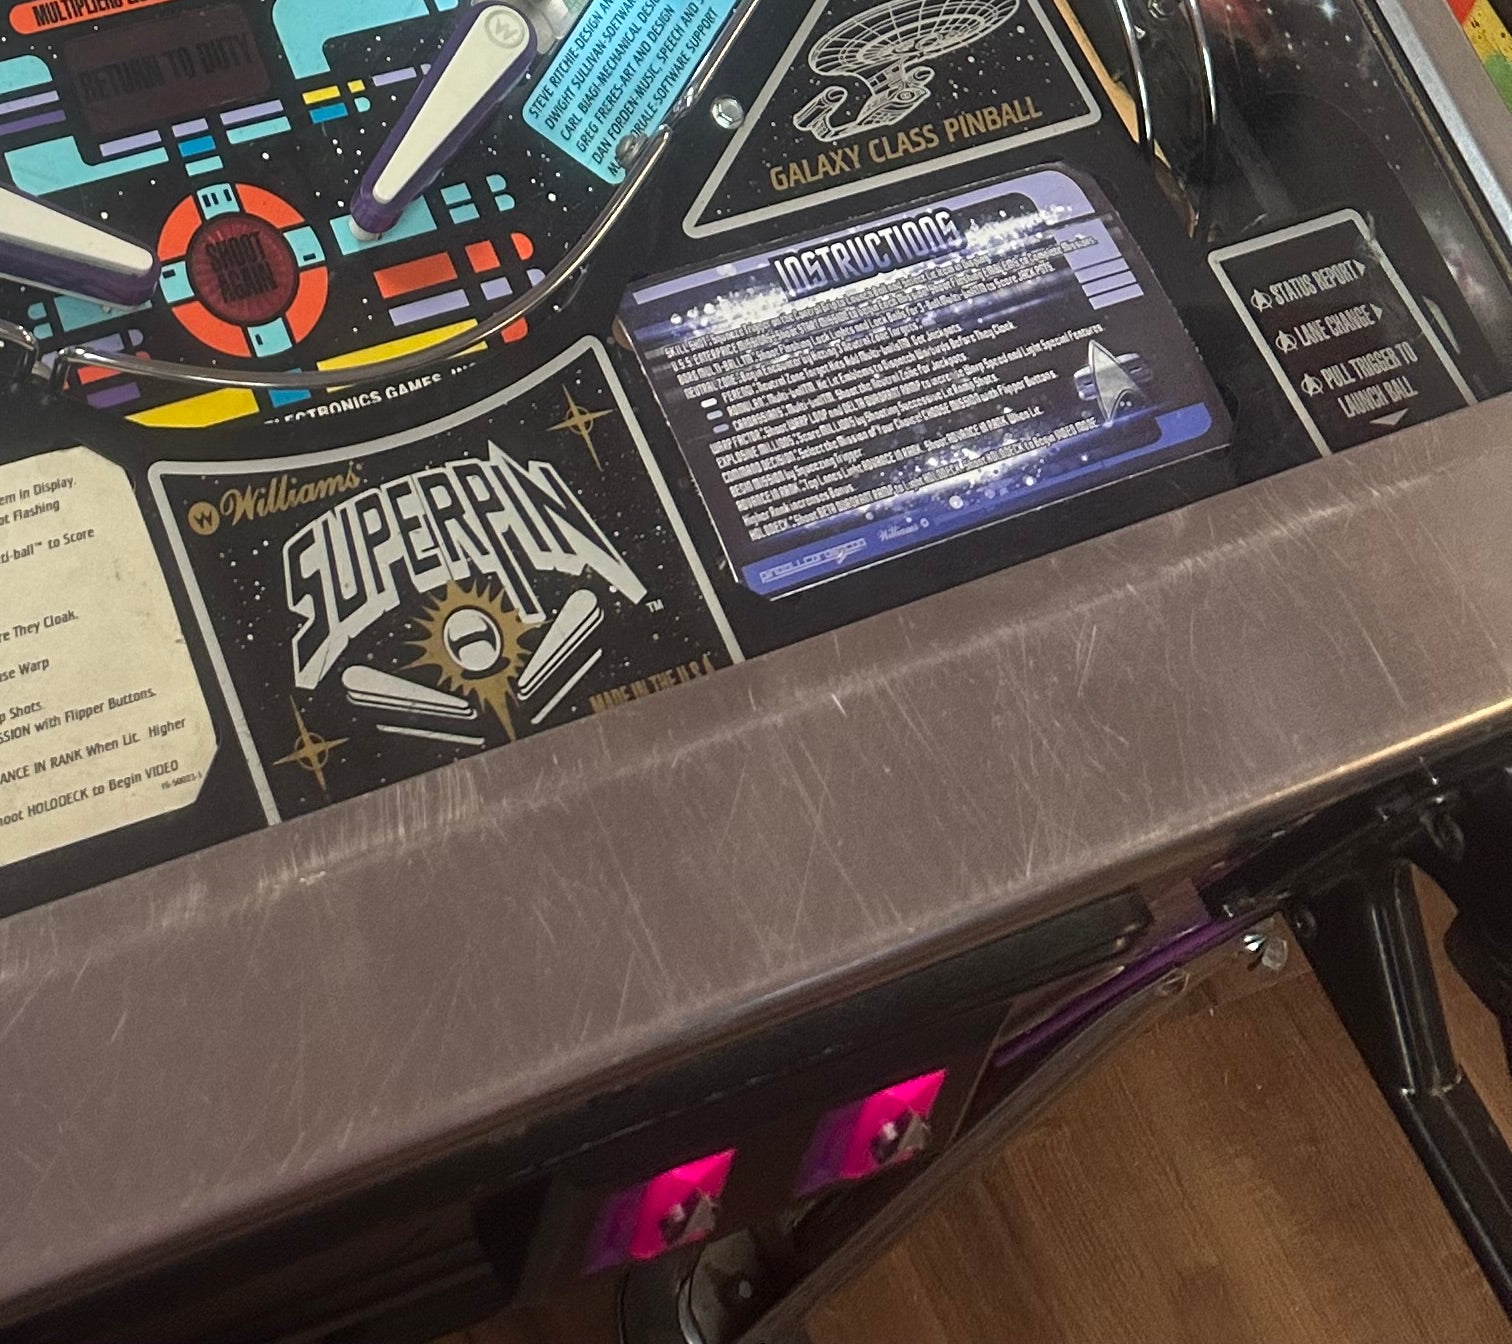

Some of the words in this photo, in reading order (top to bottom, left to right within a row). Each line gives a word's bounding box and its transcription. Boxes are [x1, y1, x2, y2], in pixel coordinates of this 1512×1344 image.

[80, 50, 165, 99] RETURN
[165, 46, 188, 76] TO
[195, 32, 254, 69] DUTY
[529, 85, 555, 119] STEVE
[552, 14, 599, 84] RITCHIE-DESIGN
[576, 122, 599, 153] GREG
[598, 64, 636, 125] FRERES-ART
[632, 41, 651, 69] AND
[648, 4, 675, 44] DESIGN
[592, 138, 612, 165] DAN
[657, 23, 685, 63] SPEECH
[682, 2, 698, 31] AND
[545, 87, 575, 130] DWIGHT
[560, 110, 584, 141] CARL
[770, 144, 861, 191] GALAXY
[868, 124, 940, 167] CLASS
[943, 97, 1044, 142] PINBALL
[774, 211, 960, 298] INSTRUCTIONS
[1269, 274, 1317, 306] STATUS
[1317, 259, 1359, 293] REPORT
[1294, 323, 1329, 349] LANE
[1329, 305, 1376, 337] CHANGE
[1320, 362, 1354, 391] PULL
[1350, 348, 1401, 380] TRIGGER
[1400, 341, 1419, 364] TO
[1337, 386, 1388, 419] LAUNCH
[1382, 375, 1419, 402] BALL
[18, 486, 31, 501] in
[32, 474, 78, 498] Display.
[219, 465, 360, 523] Williams
[283, 439, 647, 690] SUPERPIN
